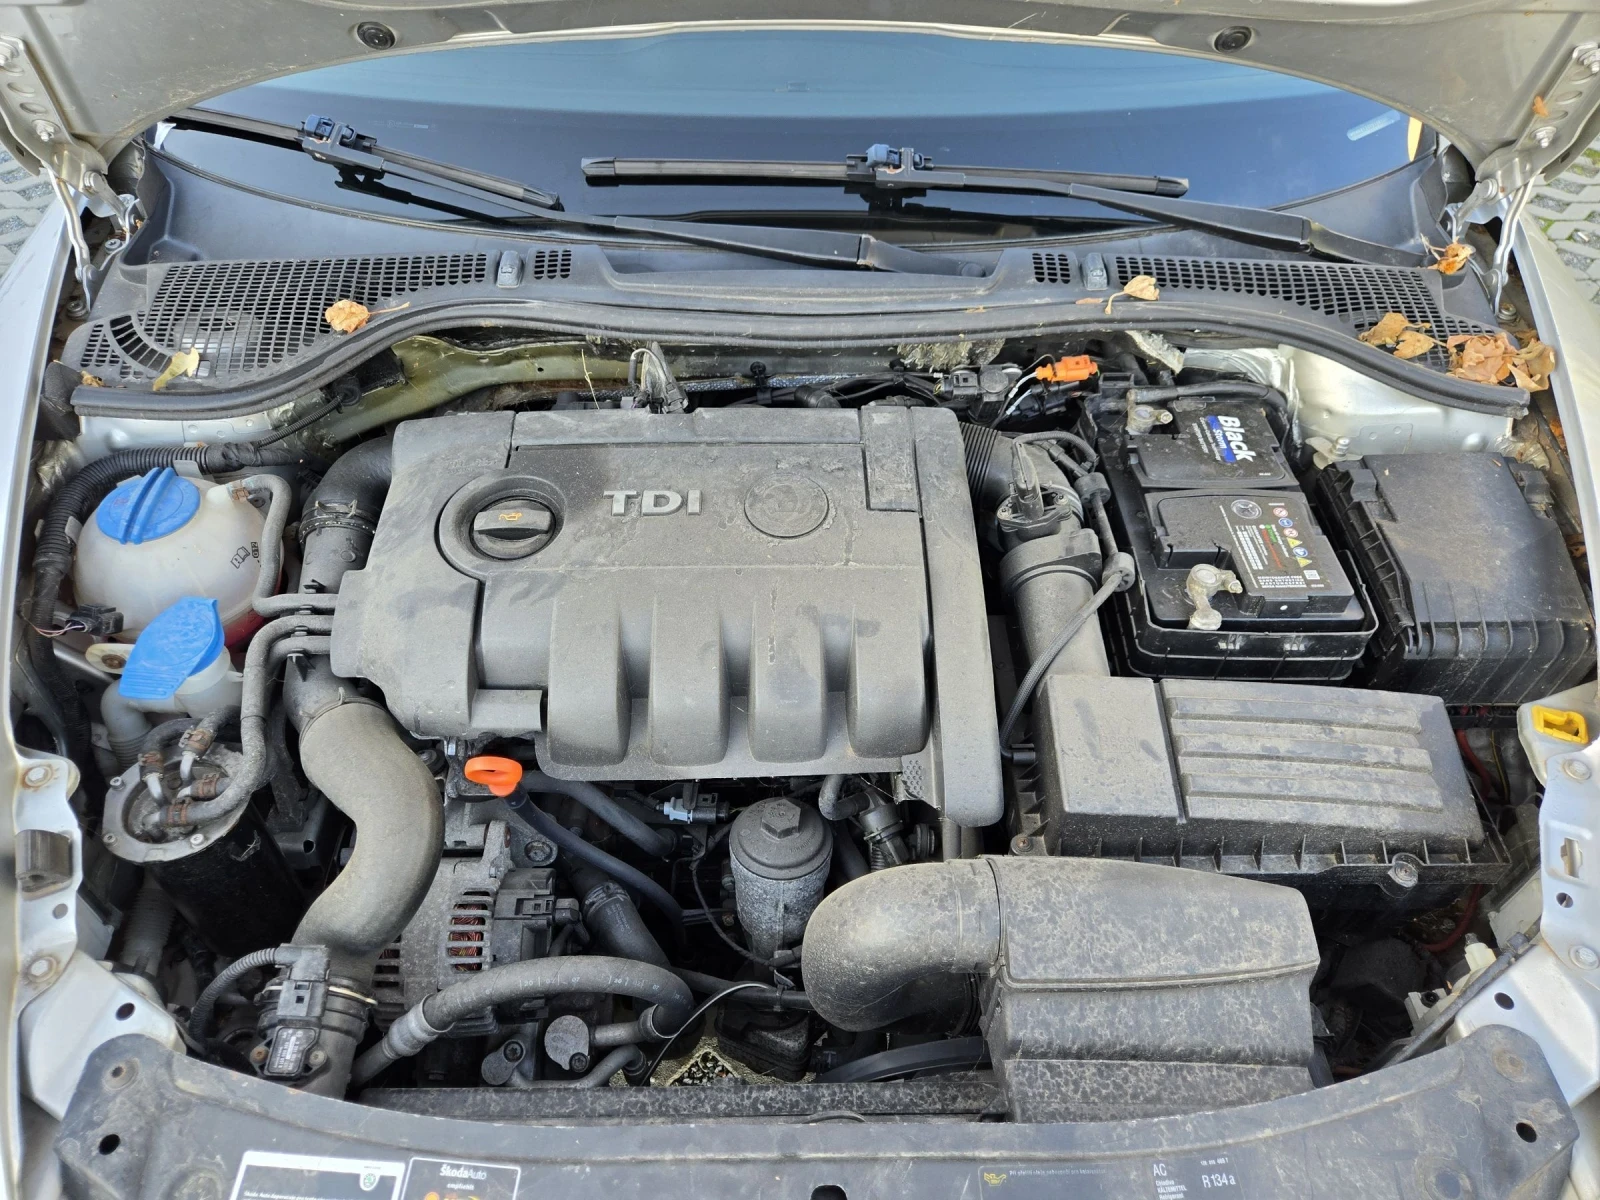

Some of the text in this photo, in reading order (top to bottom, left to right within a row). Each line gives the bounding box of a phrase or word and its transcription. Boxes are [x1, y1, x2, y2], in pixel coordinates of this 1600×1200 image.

[1217, 415, 1257, 462] Black
[603, 489, 702, 516] TDI
[1153, 1163, 1167, 1176] AC
[1210, 1173, 1228, 1187] 134
